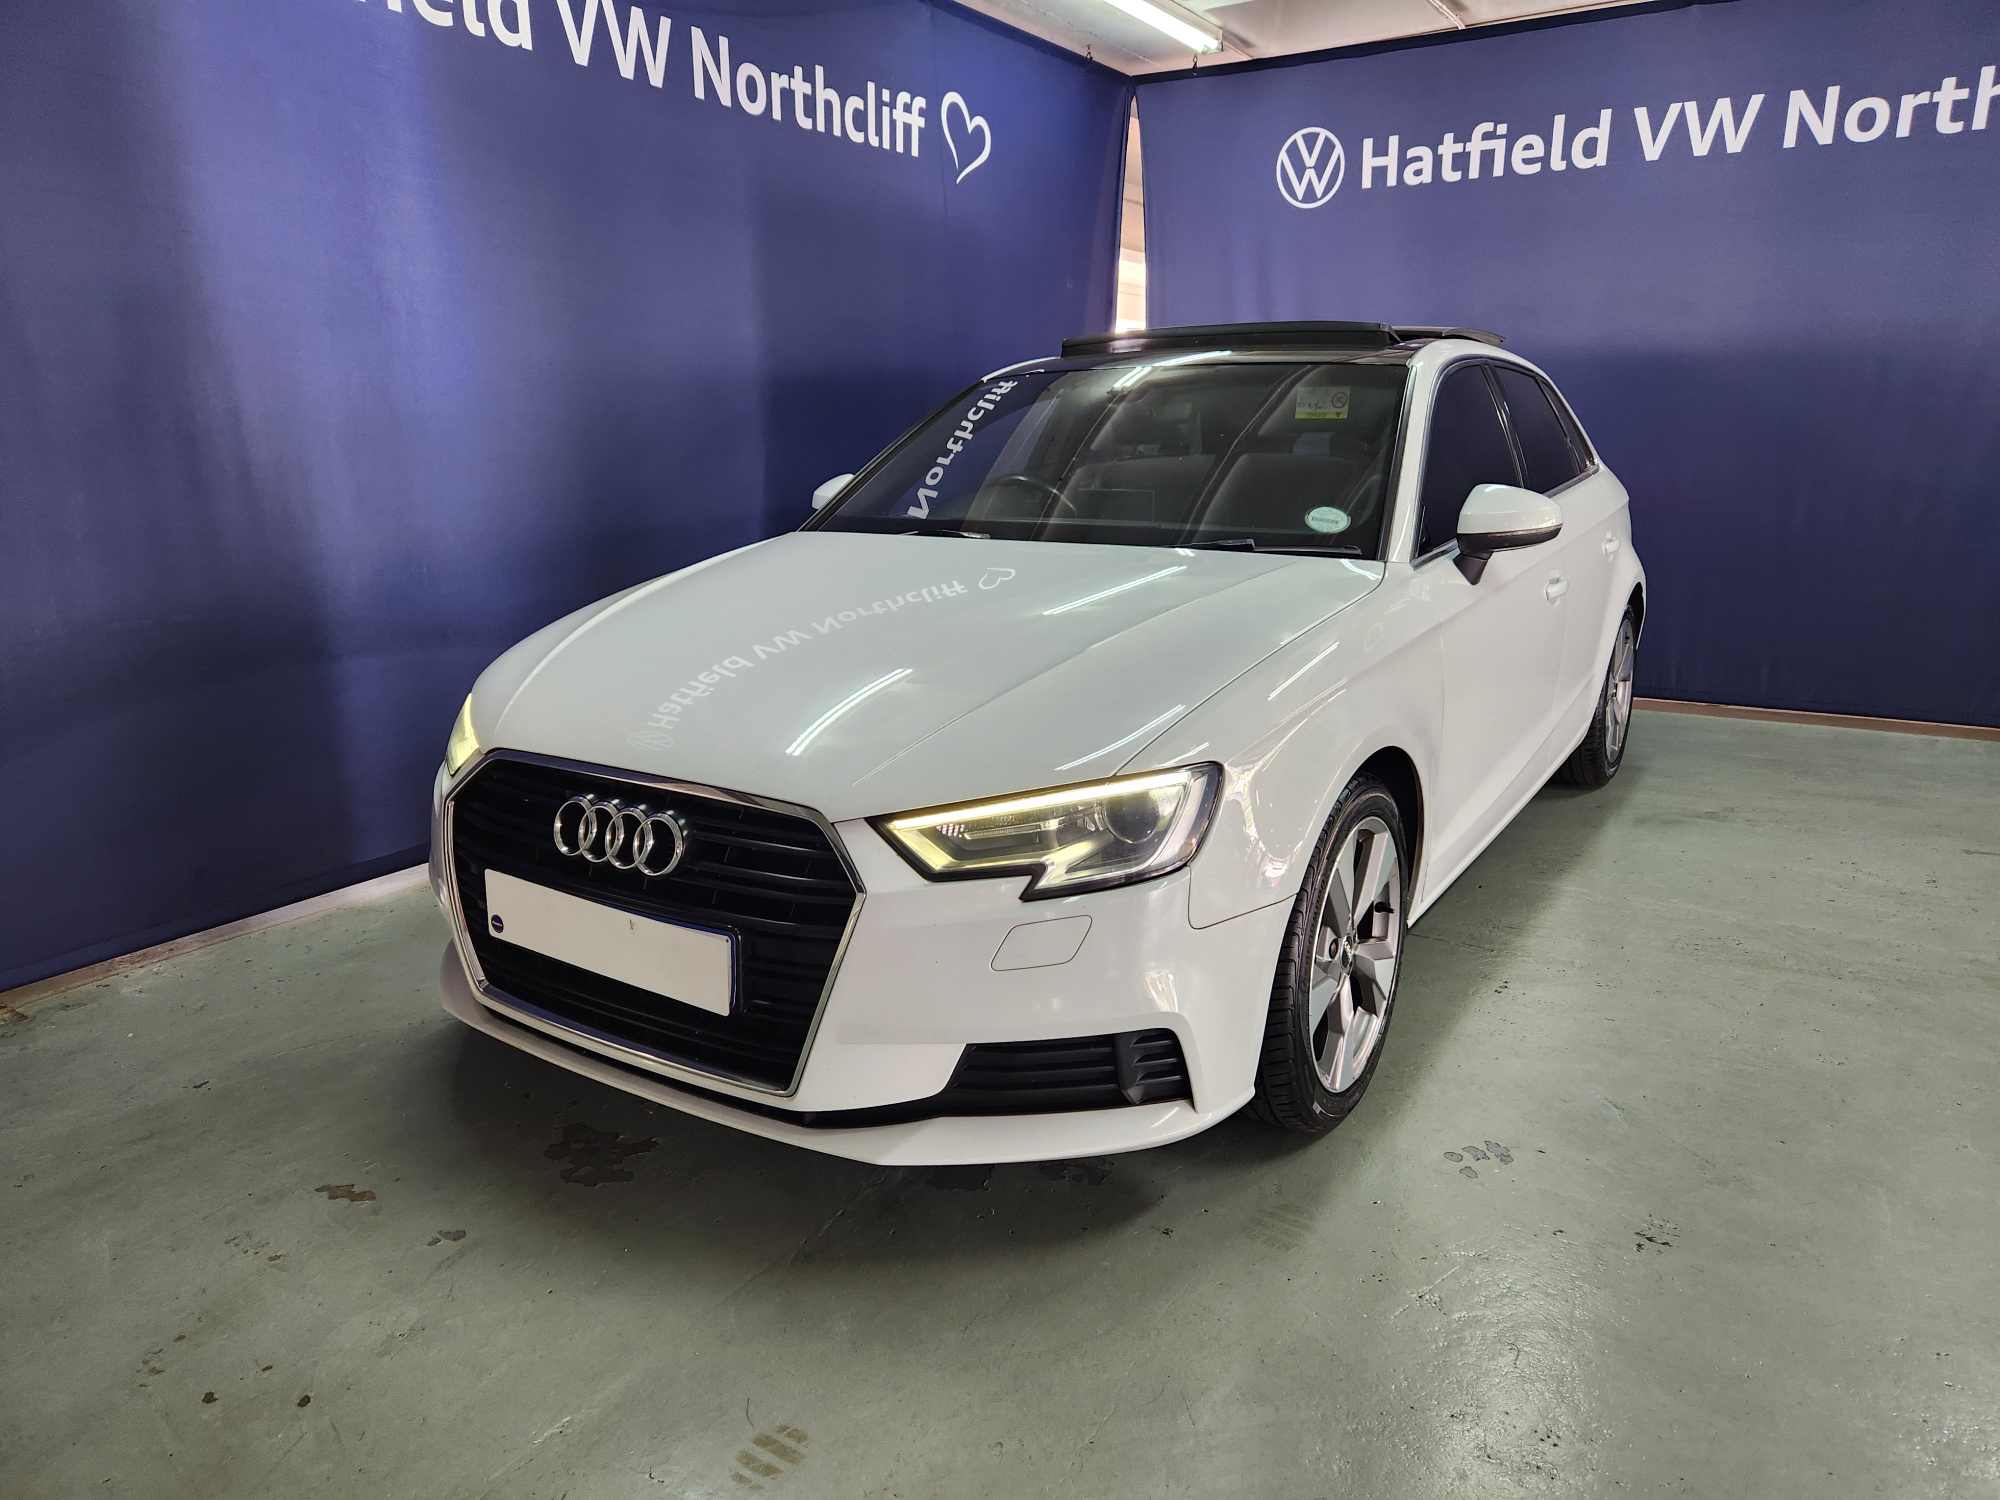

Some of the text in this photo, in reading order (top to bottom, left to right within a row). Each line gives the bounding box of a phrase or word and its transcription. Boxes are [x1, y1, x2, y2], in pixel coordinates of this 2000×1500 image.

[556, 0, 672, 89] VW
[690, 26, 927, 158] Northcliff
[1361, 108, 1613, 190] Hatfield
[1633, 93, 1766, 162] VW
